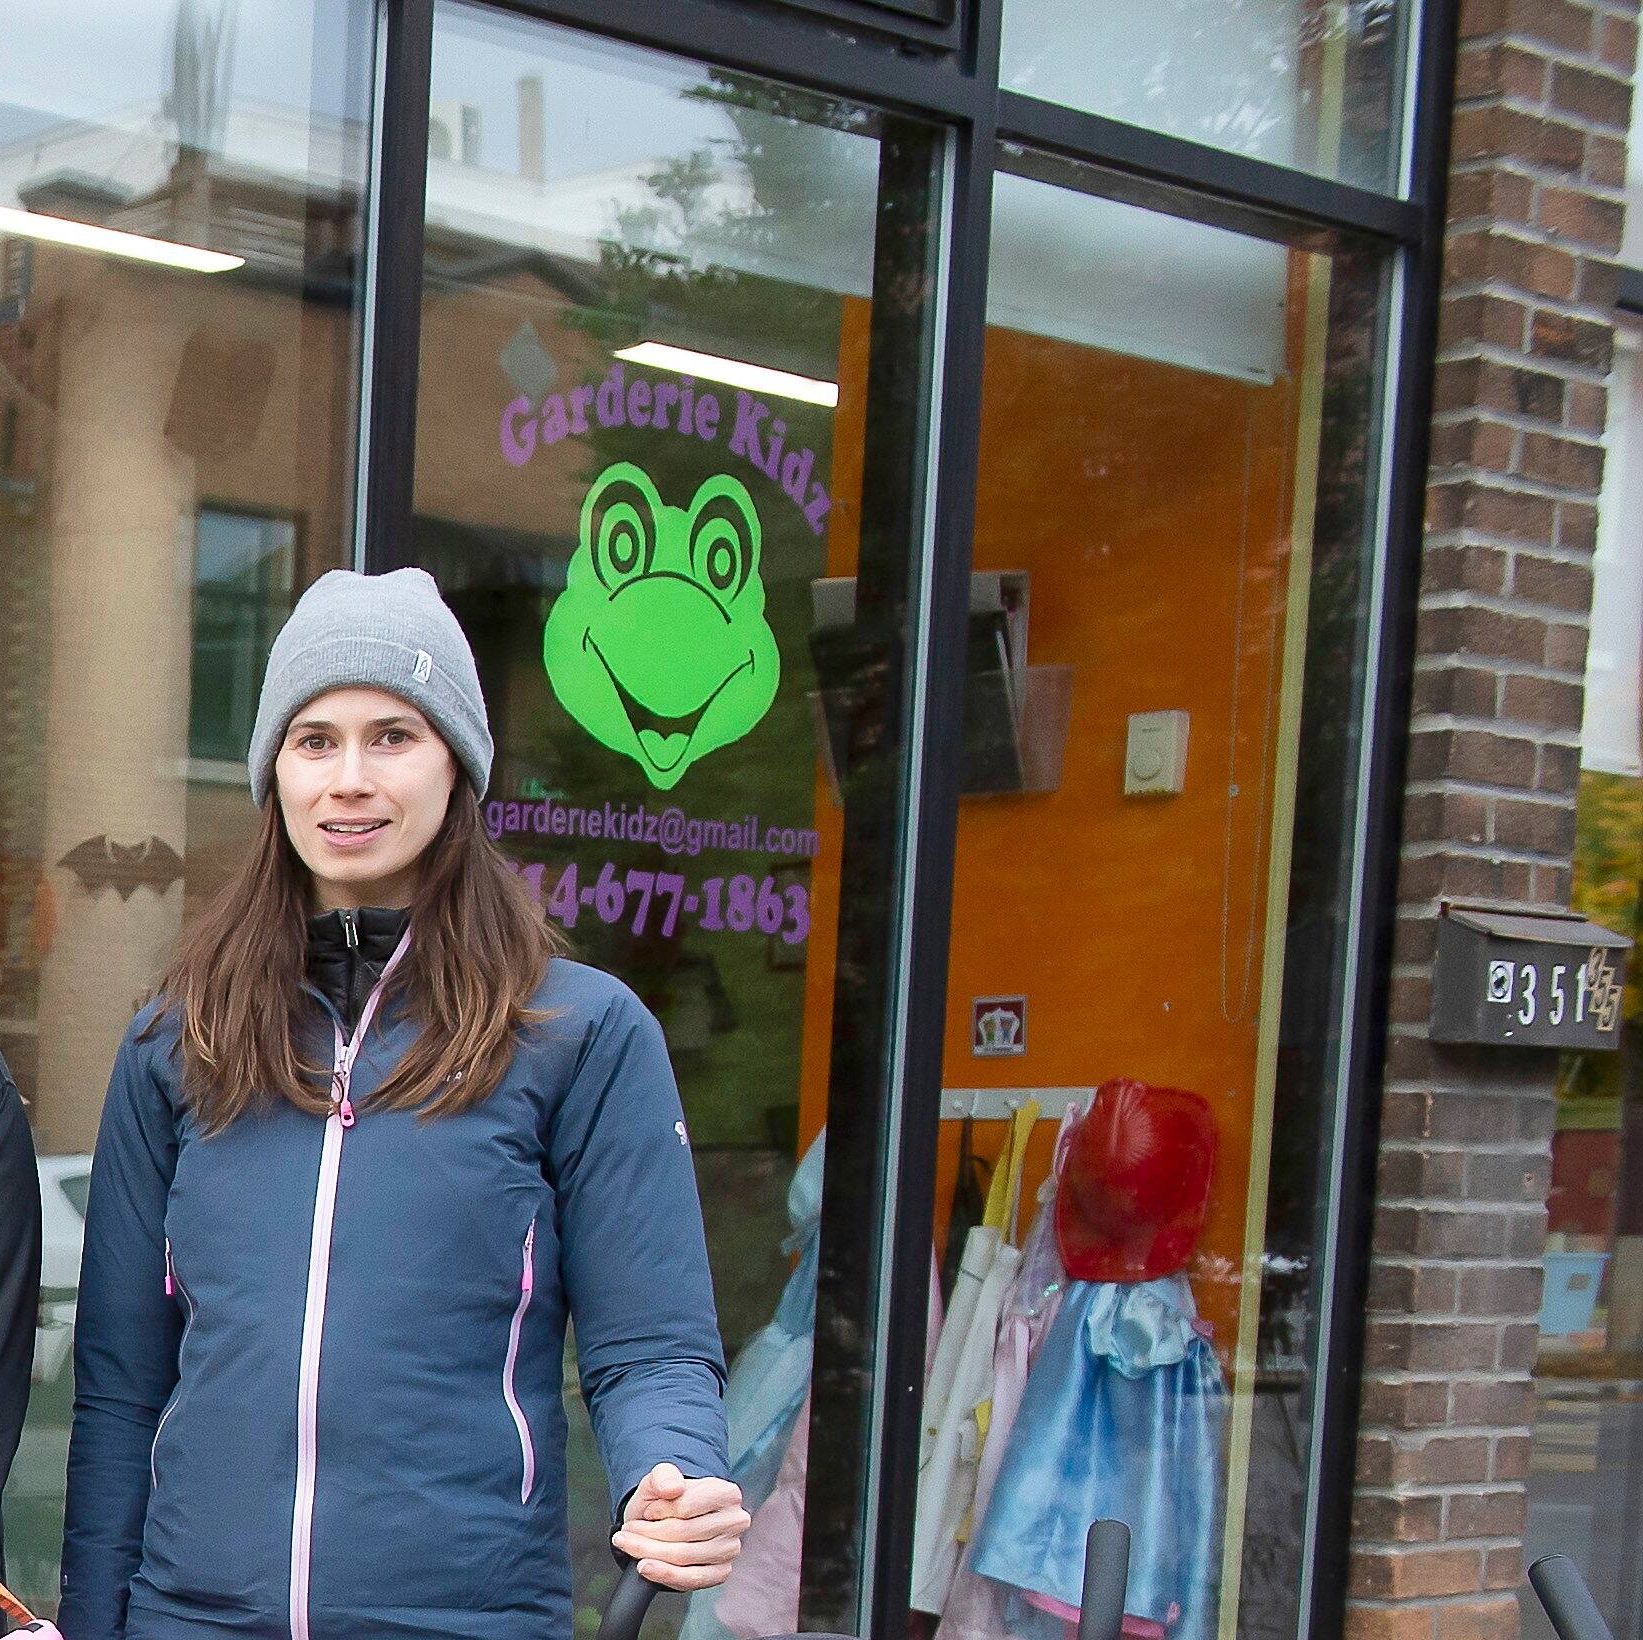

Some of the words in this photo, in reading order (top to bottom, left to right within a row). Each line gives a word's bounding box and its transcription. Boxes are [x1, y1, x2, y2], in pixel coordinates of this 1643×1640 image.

[499, 362, 721, 468] Garderie
[728, 390, 832, 536] Kidz
[484, 798, 821, 857] garderiekidz@gmail.com
[506, 859, 811, 944] 14-677-1863
[1517, 963, 1588, 1027] 351
